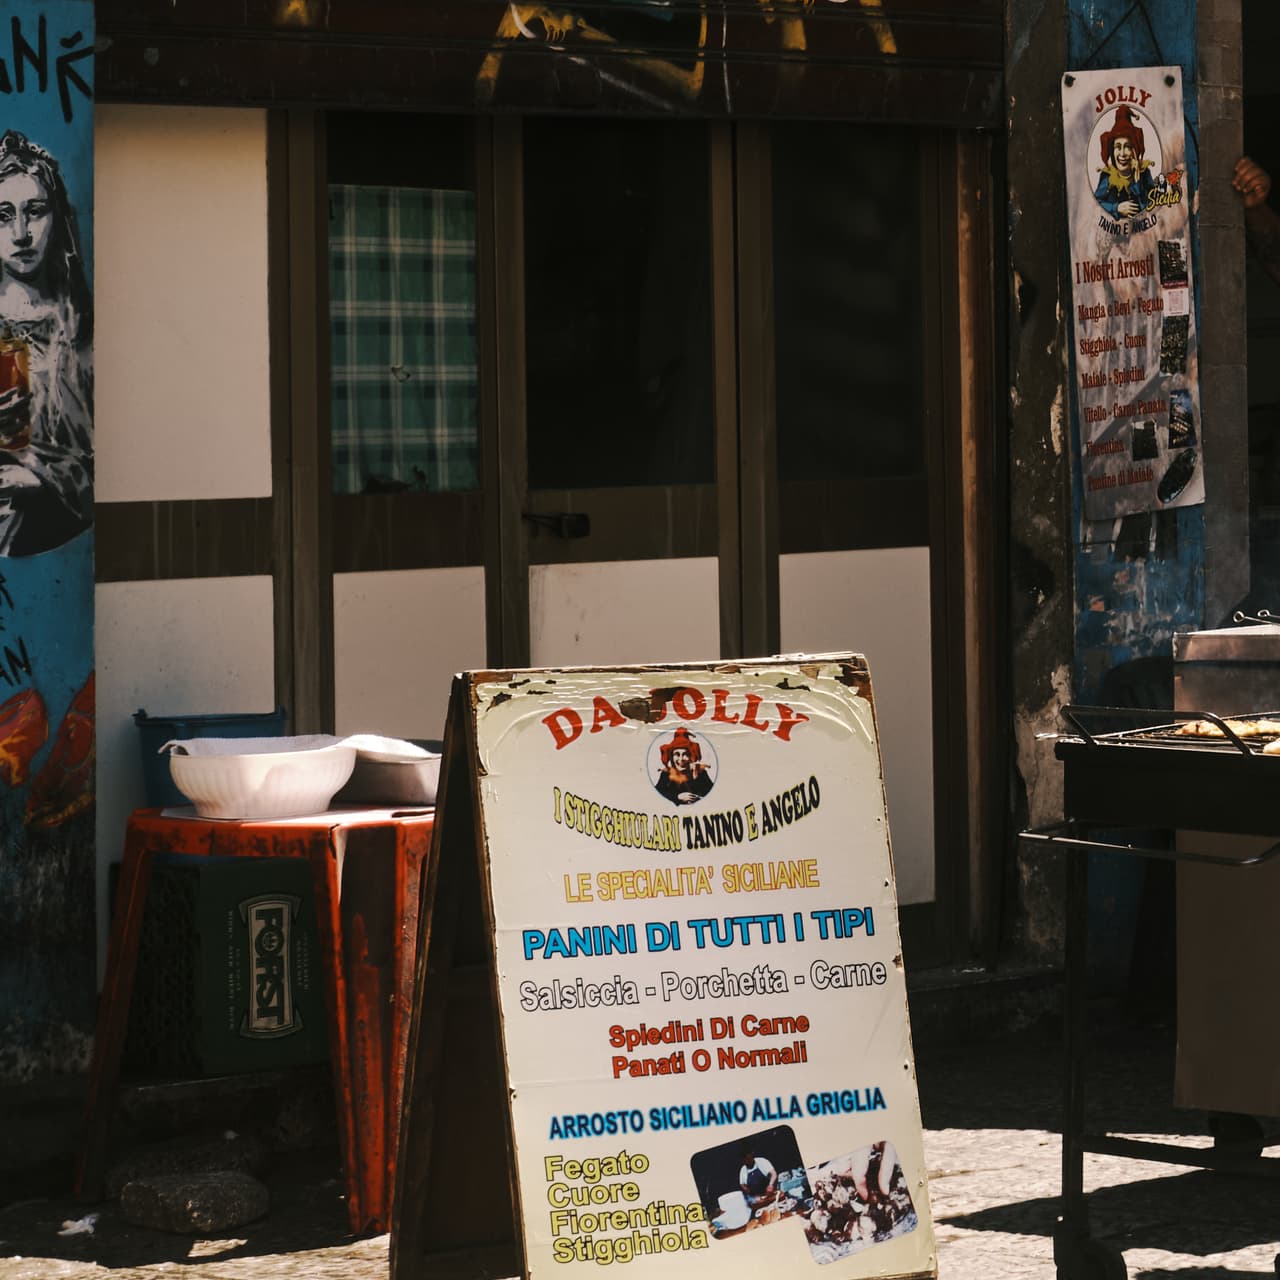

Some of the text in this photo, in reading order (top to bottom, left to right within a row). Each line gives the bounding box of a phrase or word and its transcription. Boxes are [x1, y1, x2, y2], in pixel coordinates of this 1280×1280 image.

[1096, 85, 1152, 113] JOLLY
[1082, 258, 1115, 283] Nostri
[1117, 254, 1155, 279] Arrosti
[1078, 302, 1106, 322] Mangia
[1114, 299, 1131, 317] Bevi
[1137, 296, 1164, 316] Fegato
[1080, 336, 1118, 357] Stigghiola
[1124, 333, 1147, 349] Cuore
[1082, 370, 1107, 389] Maiale
[1113, 365, 1145, 387] Spiedini
[1084, 405, 1107, 423] Vitello
[1113, 402, 1136, 418] Carne
[542, 696, 627, 750] DA
[553, 775, 821, 852] I STIGGHIULARI TANINO E ANGELO
[563, 872, 594, 903] LE
[722, 858, 820, 894] SICILIANE
[522, 907, 875, 960] PANINI DI TUTTI I TIPI
[519, 975, 640, 1013] Salsiccia
[661, 963, 789, 1003] Porchetta
[810, 959, 887, 990] Carne
[608, 1013, 810, 1052] Spiedini Di Carne
[612, 1040, 808, 1079] Panati O Normali
[549, 1086, 887, 1141] ARROSTO SICILIANO ALLA GRIGLIA
[544, 1149, 650, 1184] Fegato
[547, 1181, 641, 1209] Cuore
[550, 1200, 706, 1237] Fiorentina
[552, 1224, 710, 1266] Stigghiola
